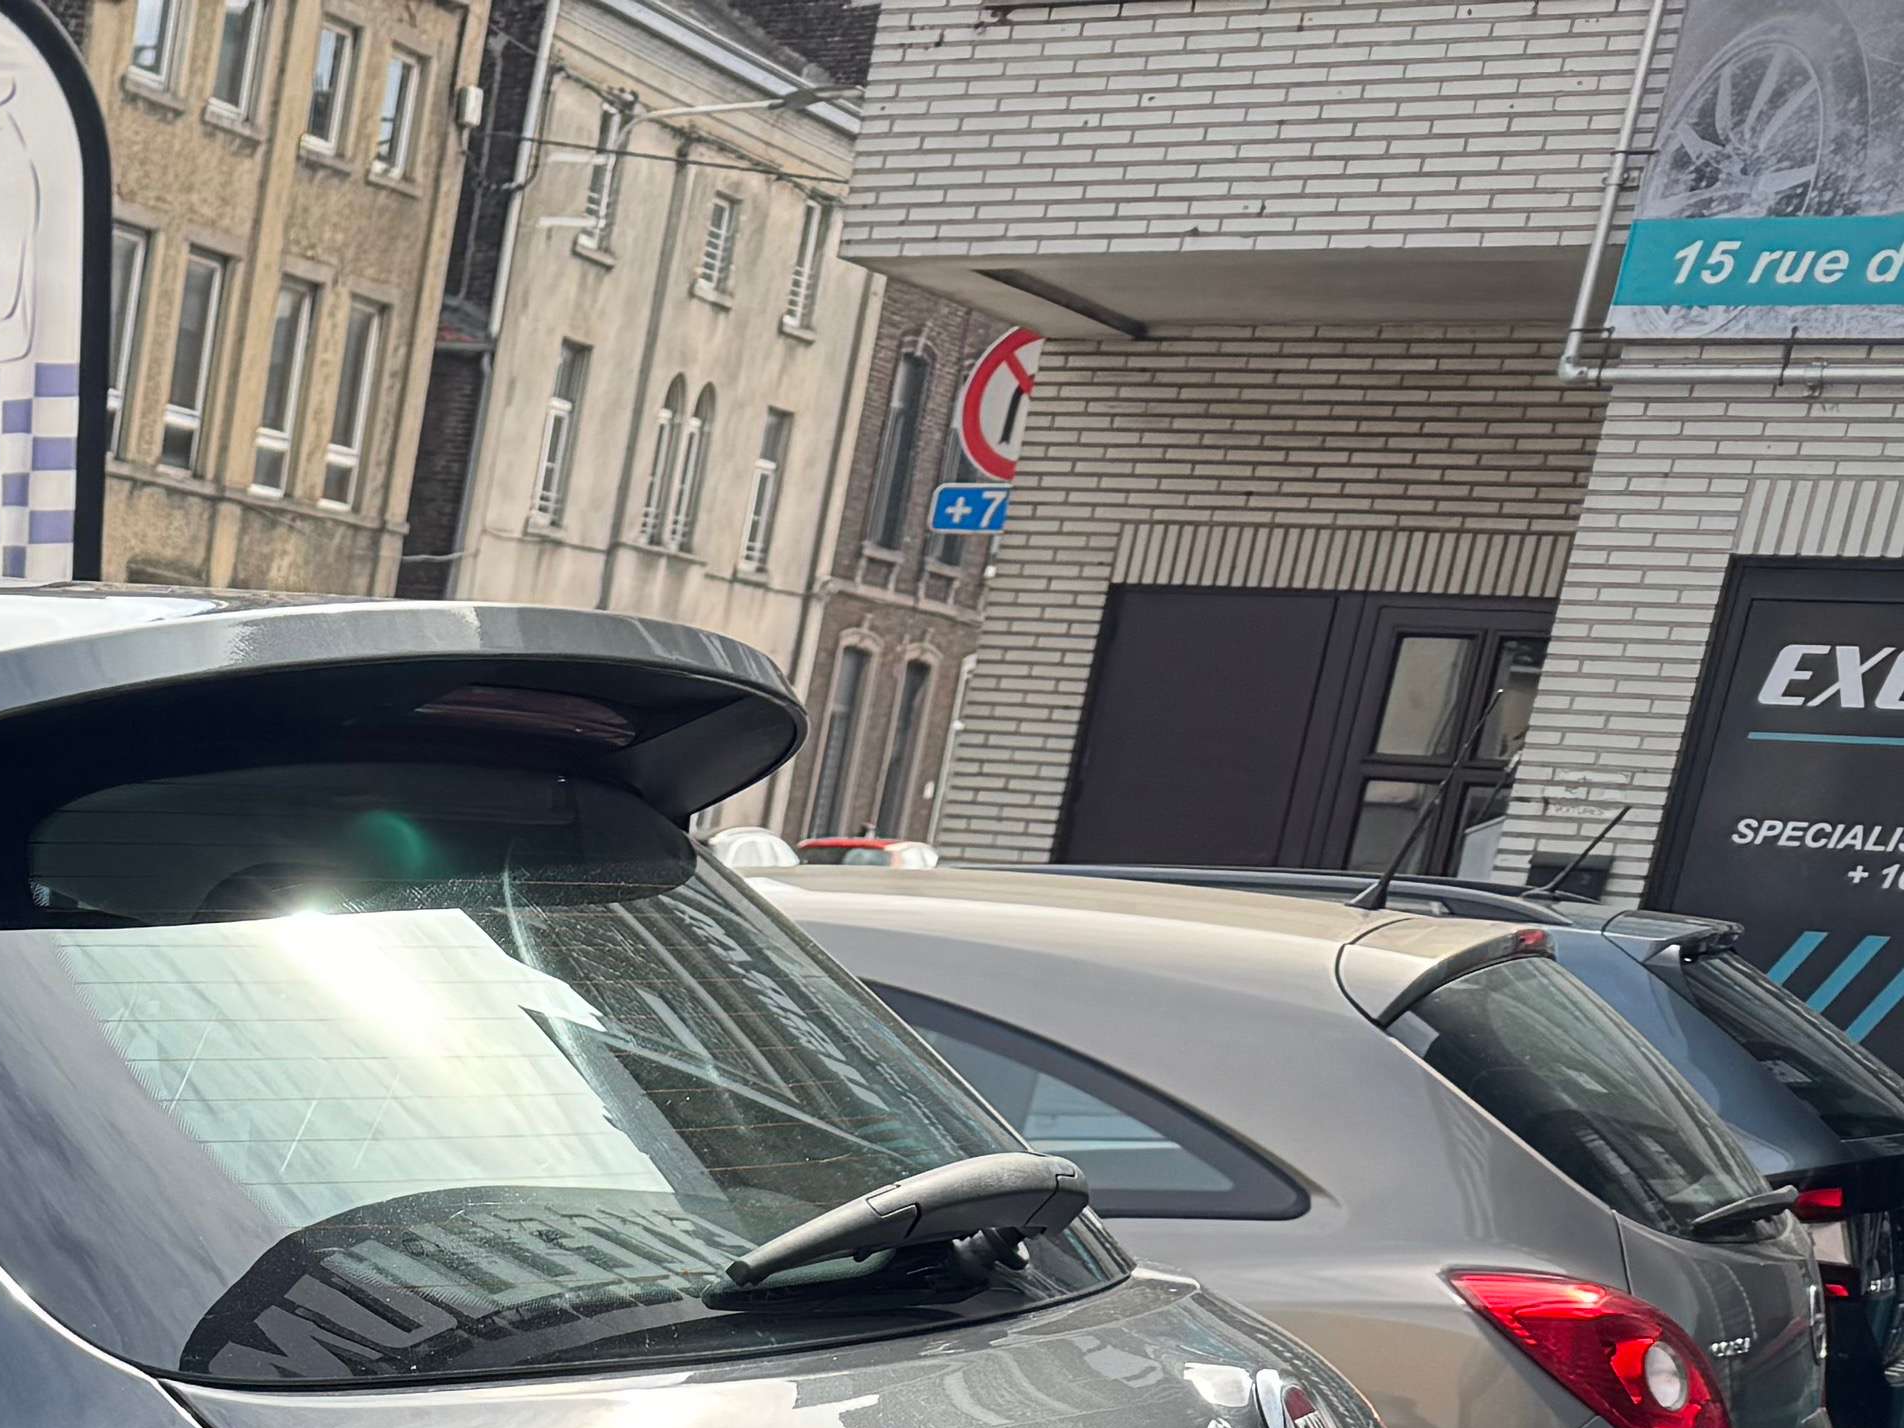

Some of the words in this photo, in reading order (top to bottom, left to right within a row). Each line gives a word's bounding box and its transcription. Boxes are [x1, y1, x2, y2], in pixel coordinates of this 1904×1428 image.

[1674, 240, 1741, 284] 15
[1748, 250, 1849, 284] rue
[1731, 818, 1904, 852] SPECIALI
